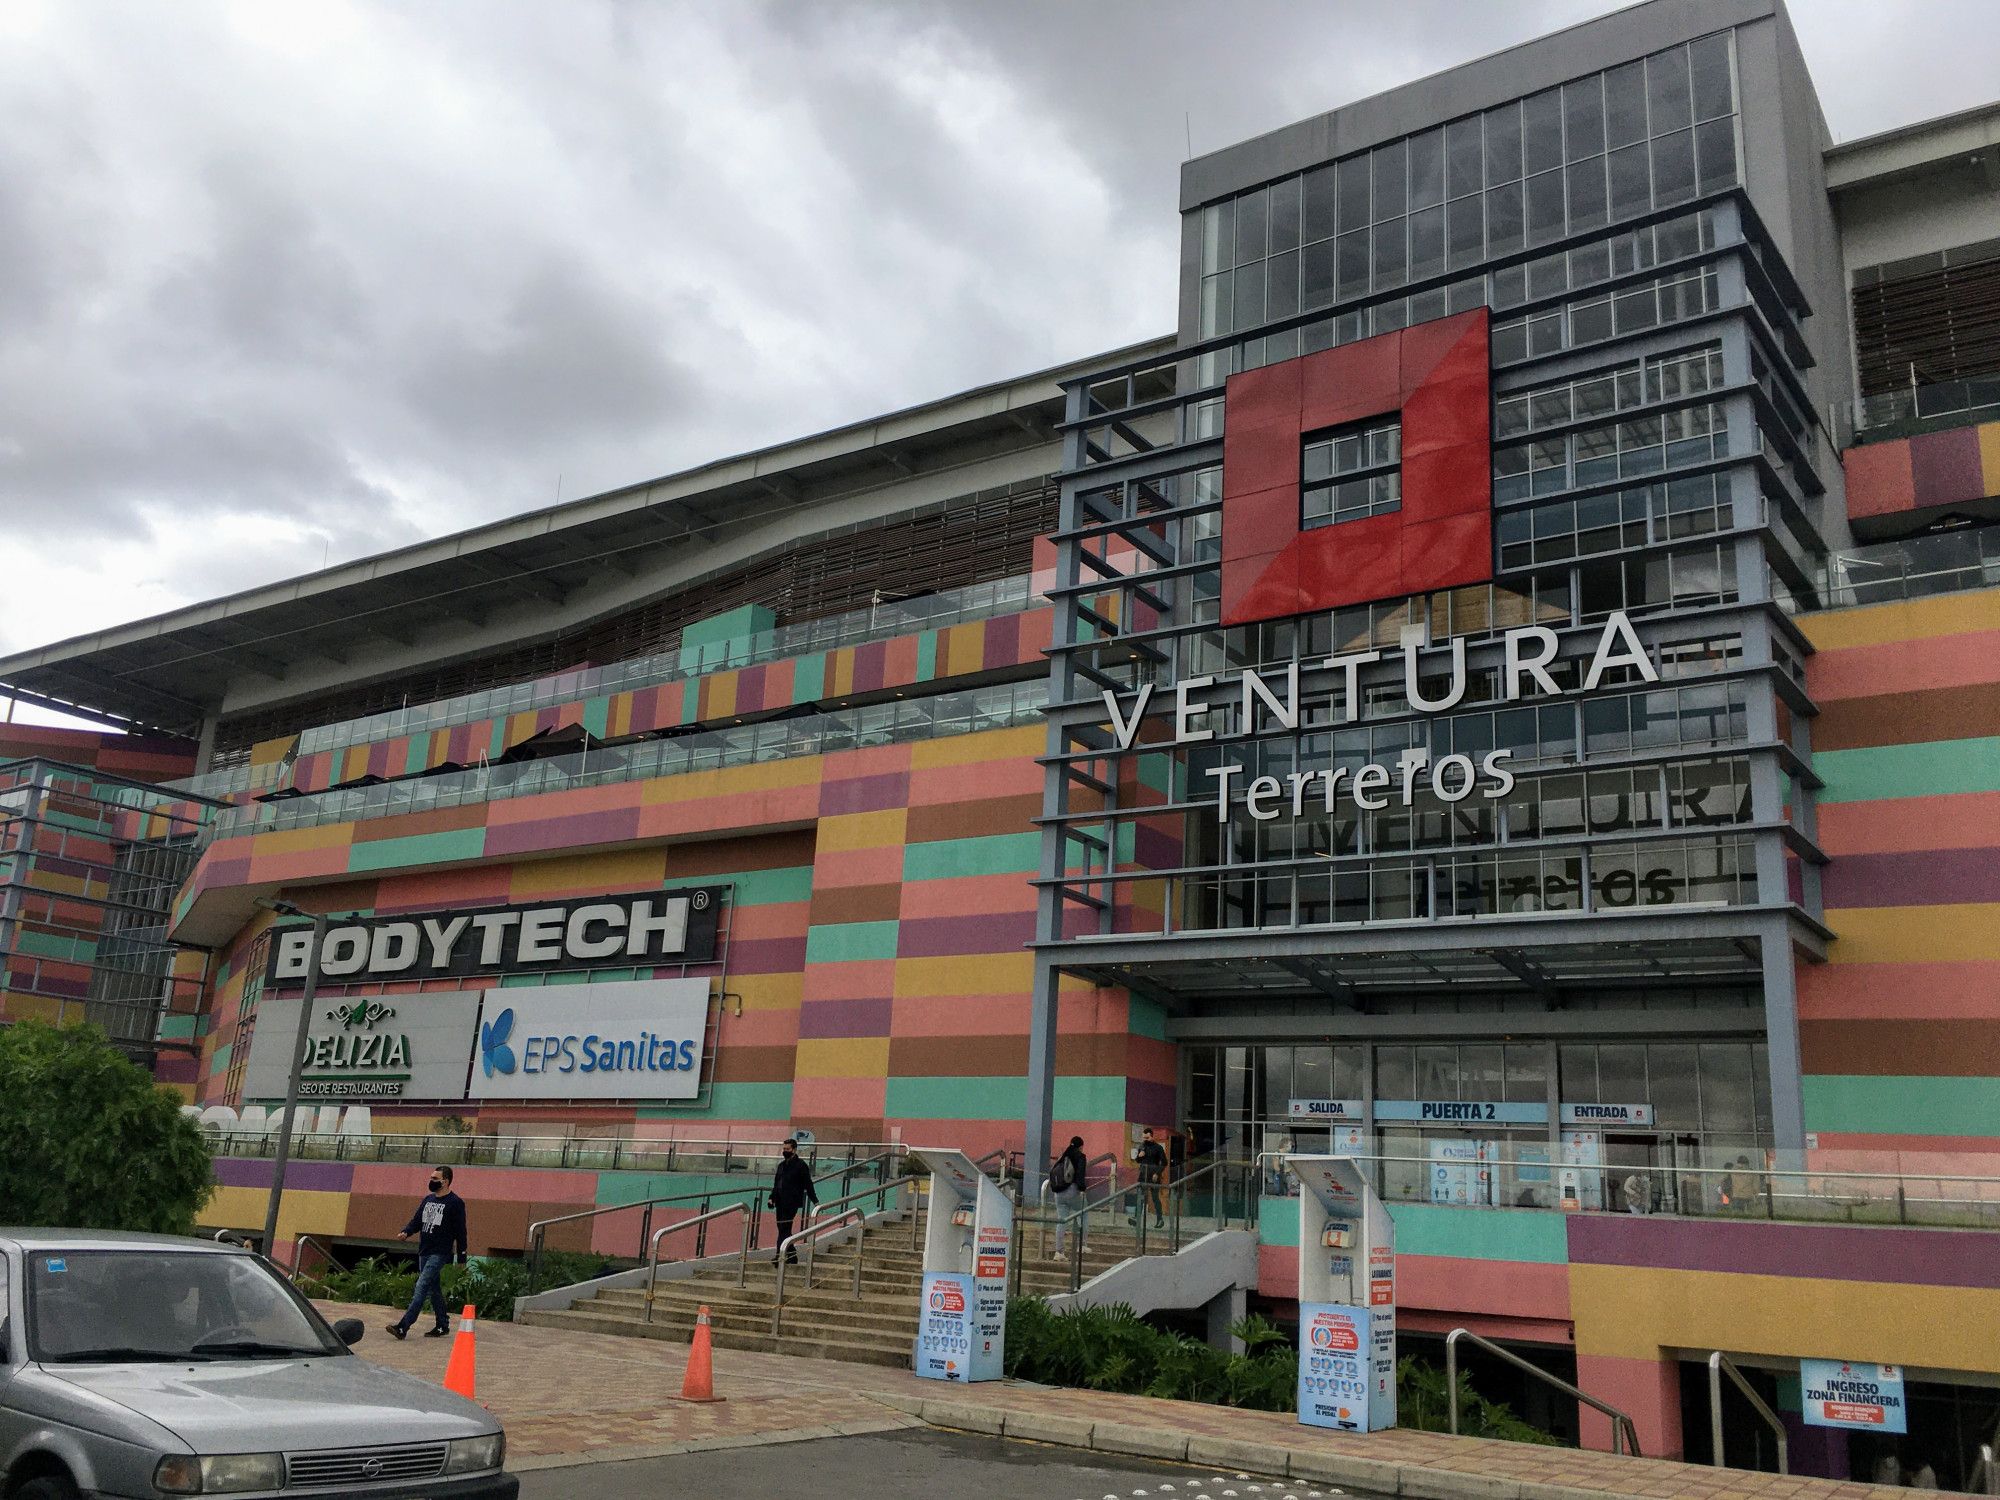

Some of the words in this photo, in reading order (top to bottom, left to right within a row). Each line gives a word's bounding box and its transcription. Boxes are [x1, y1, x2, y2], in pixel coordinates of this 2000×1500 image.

[1101, 611, 1660, 750] VENTURA
[1205, 747, 1517, 823] Terreros
[318, 1082, 333, 1095] DE
[332, 1081, 401, 1095] RESTAURANTES
[1308, 1102, 1344, 1114] SALIDA
[1422, 1103, 1482, 1119] PUERTA
[1485, 1104, 1496, 1119] 2
[1574, 1106, 1628, 1118] ENTRADA
[1826, 1379, 1879, 1394] INGRESO
[1806, 1389, 1836, 1402] ZONA
[1838, 1392, 1900, 1407] FINANCIERA
